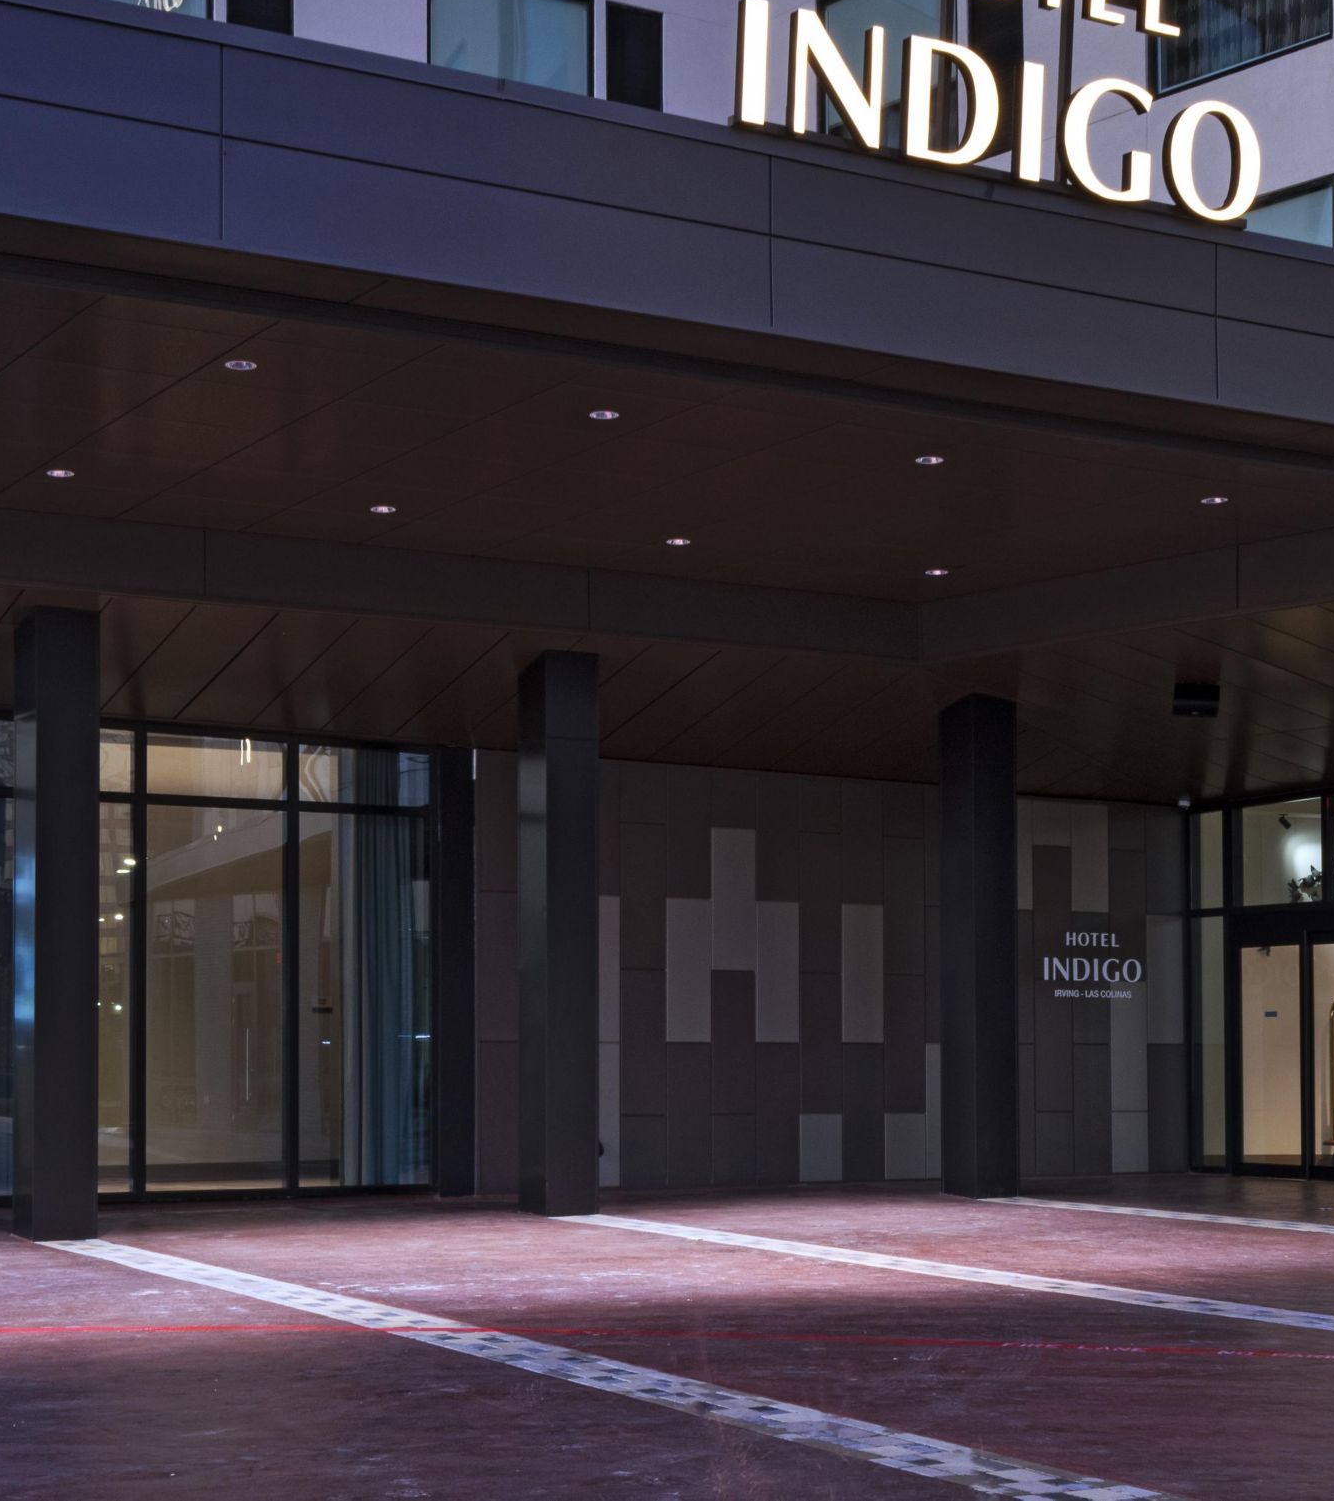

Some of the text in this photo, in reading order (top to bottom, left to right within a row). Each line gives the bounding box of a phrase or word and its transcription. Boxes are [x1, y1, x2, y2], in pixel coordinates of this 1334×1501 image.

[1065, 932, 1120, 948] HOTEL
[1043, 956, 1142, 983] INDIGO
[1054, 989, 1080, 998] IRVING
[1084, 989, 1099, 998] LAS
[1100, 989, 1132, 999] COLINAS
